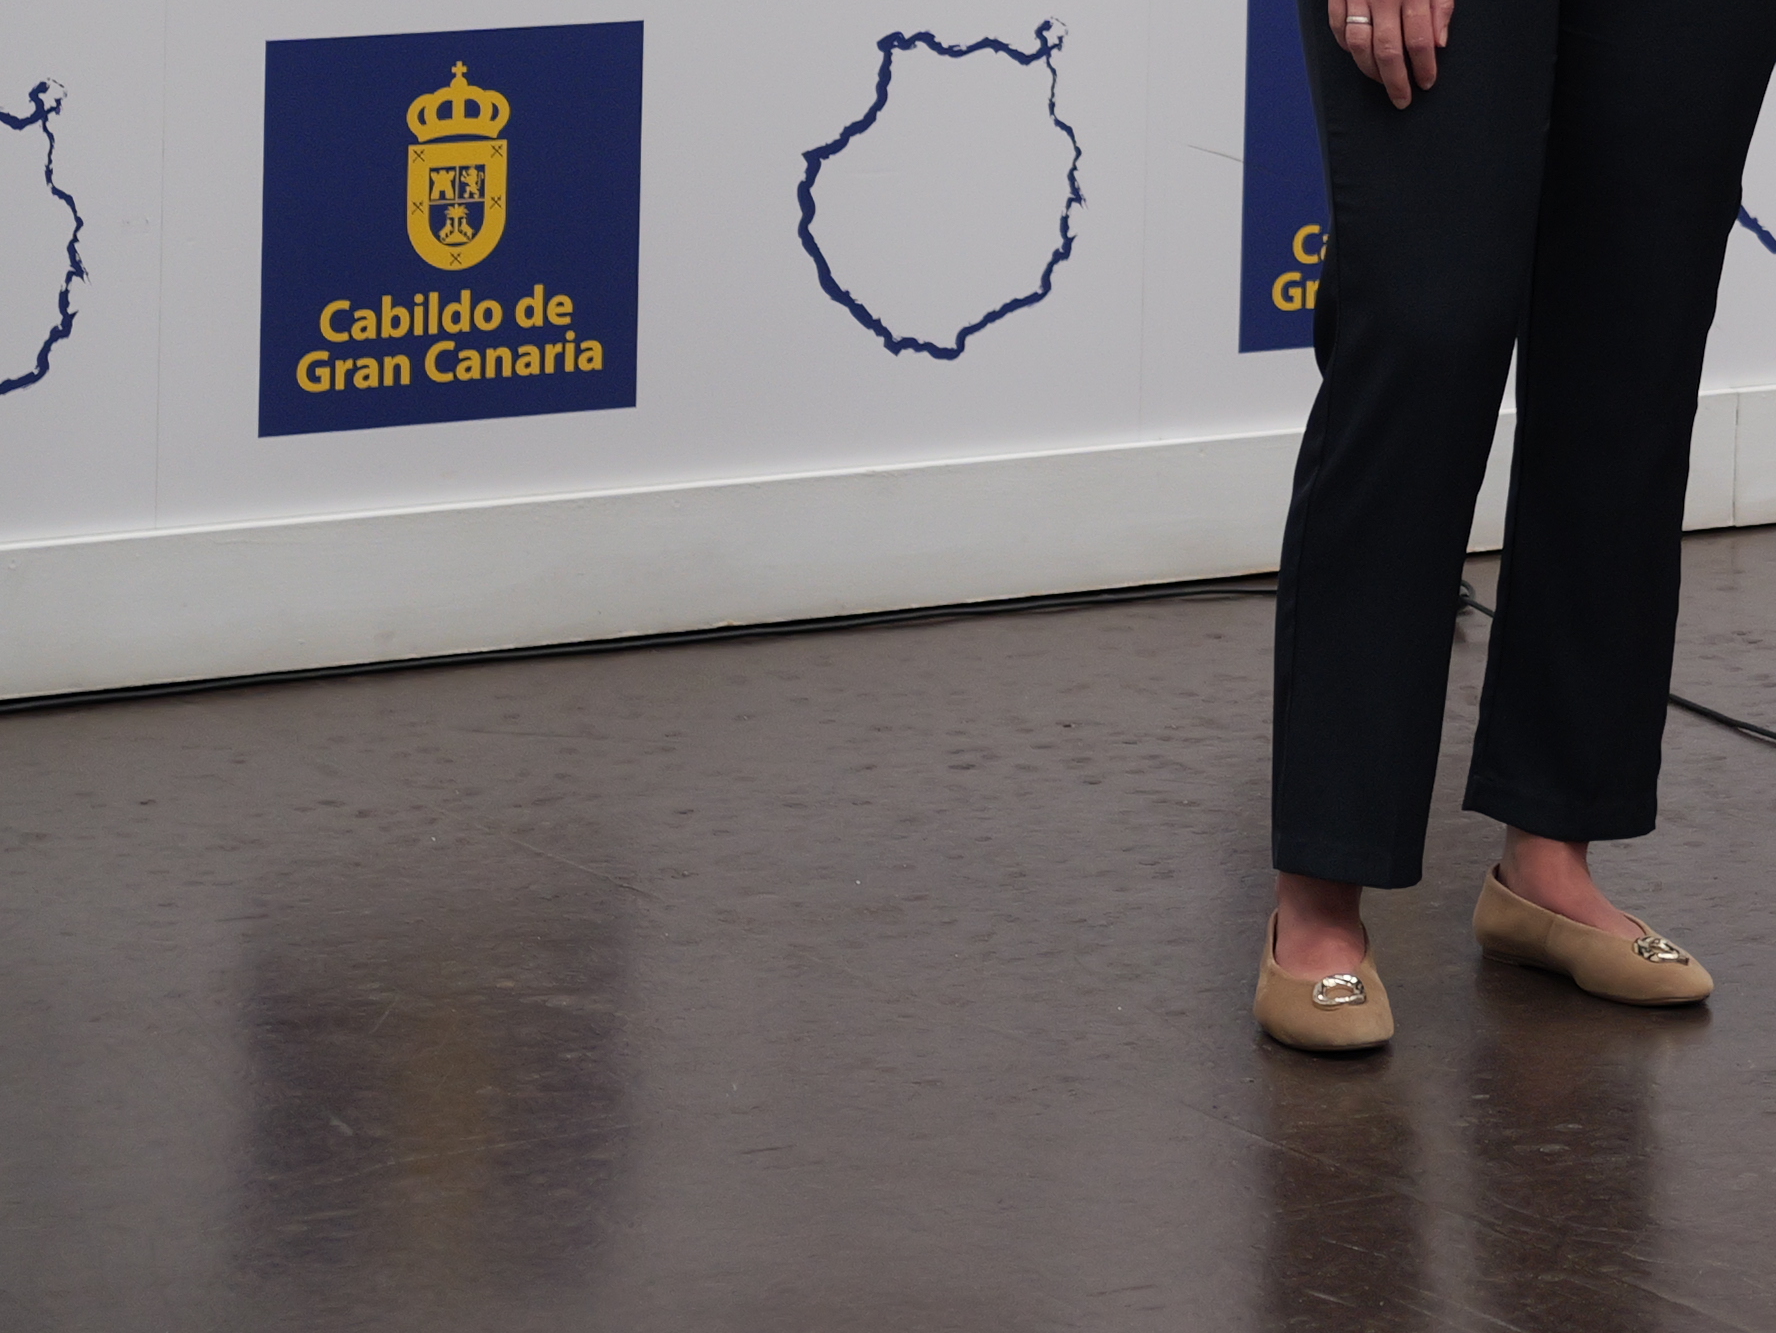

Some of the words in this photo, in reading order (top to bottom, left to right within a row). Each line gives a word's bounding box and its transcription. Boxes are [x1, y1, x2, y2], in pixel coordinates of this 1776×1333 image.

[320, 288, 503, 342] Cabildo
[516, 282, 573, 329] de
[1271, 271, 1321, 312] Gr
[297, 347, 410, 392] Gran
[426, 331, 602, 384] Canaria
